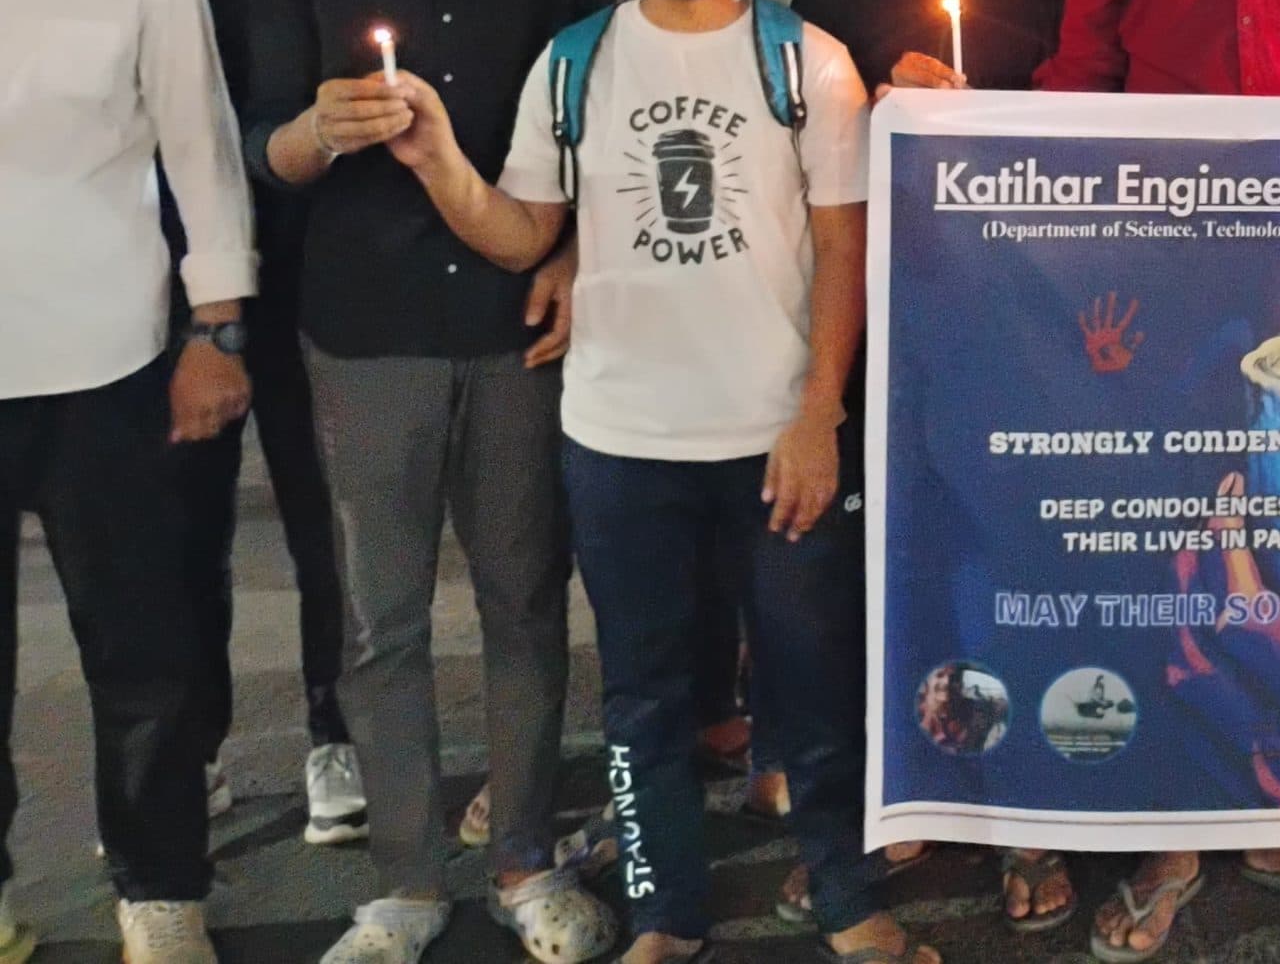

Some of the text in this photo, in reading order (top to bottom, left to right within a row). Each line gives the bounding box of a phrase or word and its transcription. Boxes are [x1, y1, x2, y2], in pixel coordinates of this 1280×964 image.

[629, 96, 748, 137] COFFEE
[936, 158, 1103, 206] Katihar
[632, 226, 751, 265] POWER
[982, 219, 1097, 242] (Department
[1102, 220, 1123, 238] of
[1125, 219, 1199, 240] Science,
[988, 431, 1154, 455] STRONGLY
[1039, 498, 1105, 520] DEEP
[1062, 531, 1138, 553] THEIR
[1144, 530, 1215, 552] LIVES
[1220, 528, 1246, 550] IN
[995, 592, 1088, 627] MAY
[1095, 592, 1218, 627] THEIR
[609, 744, 656, 900] STAUNCH
